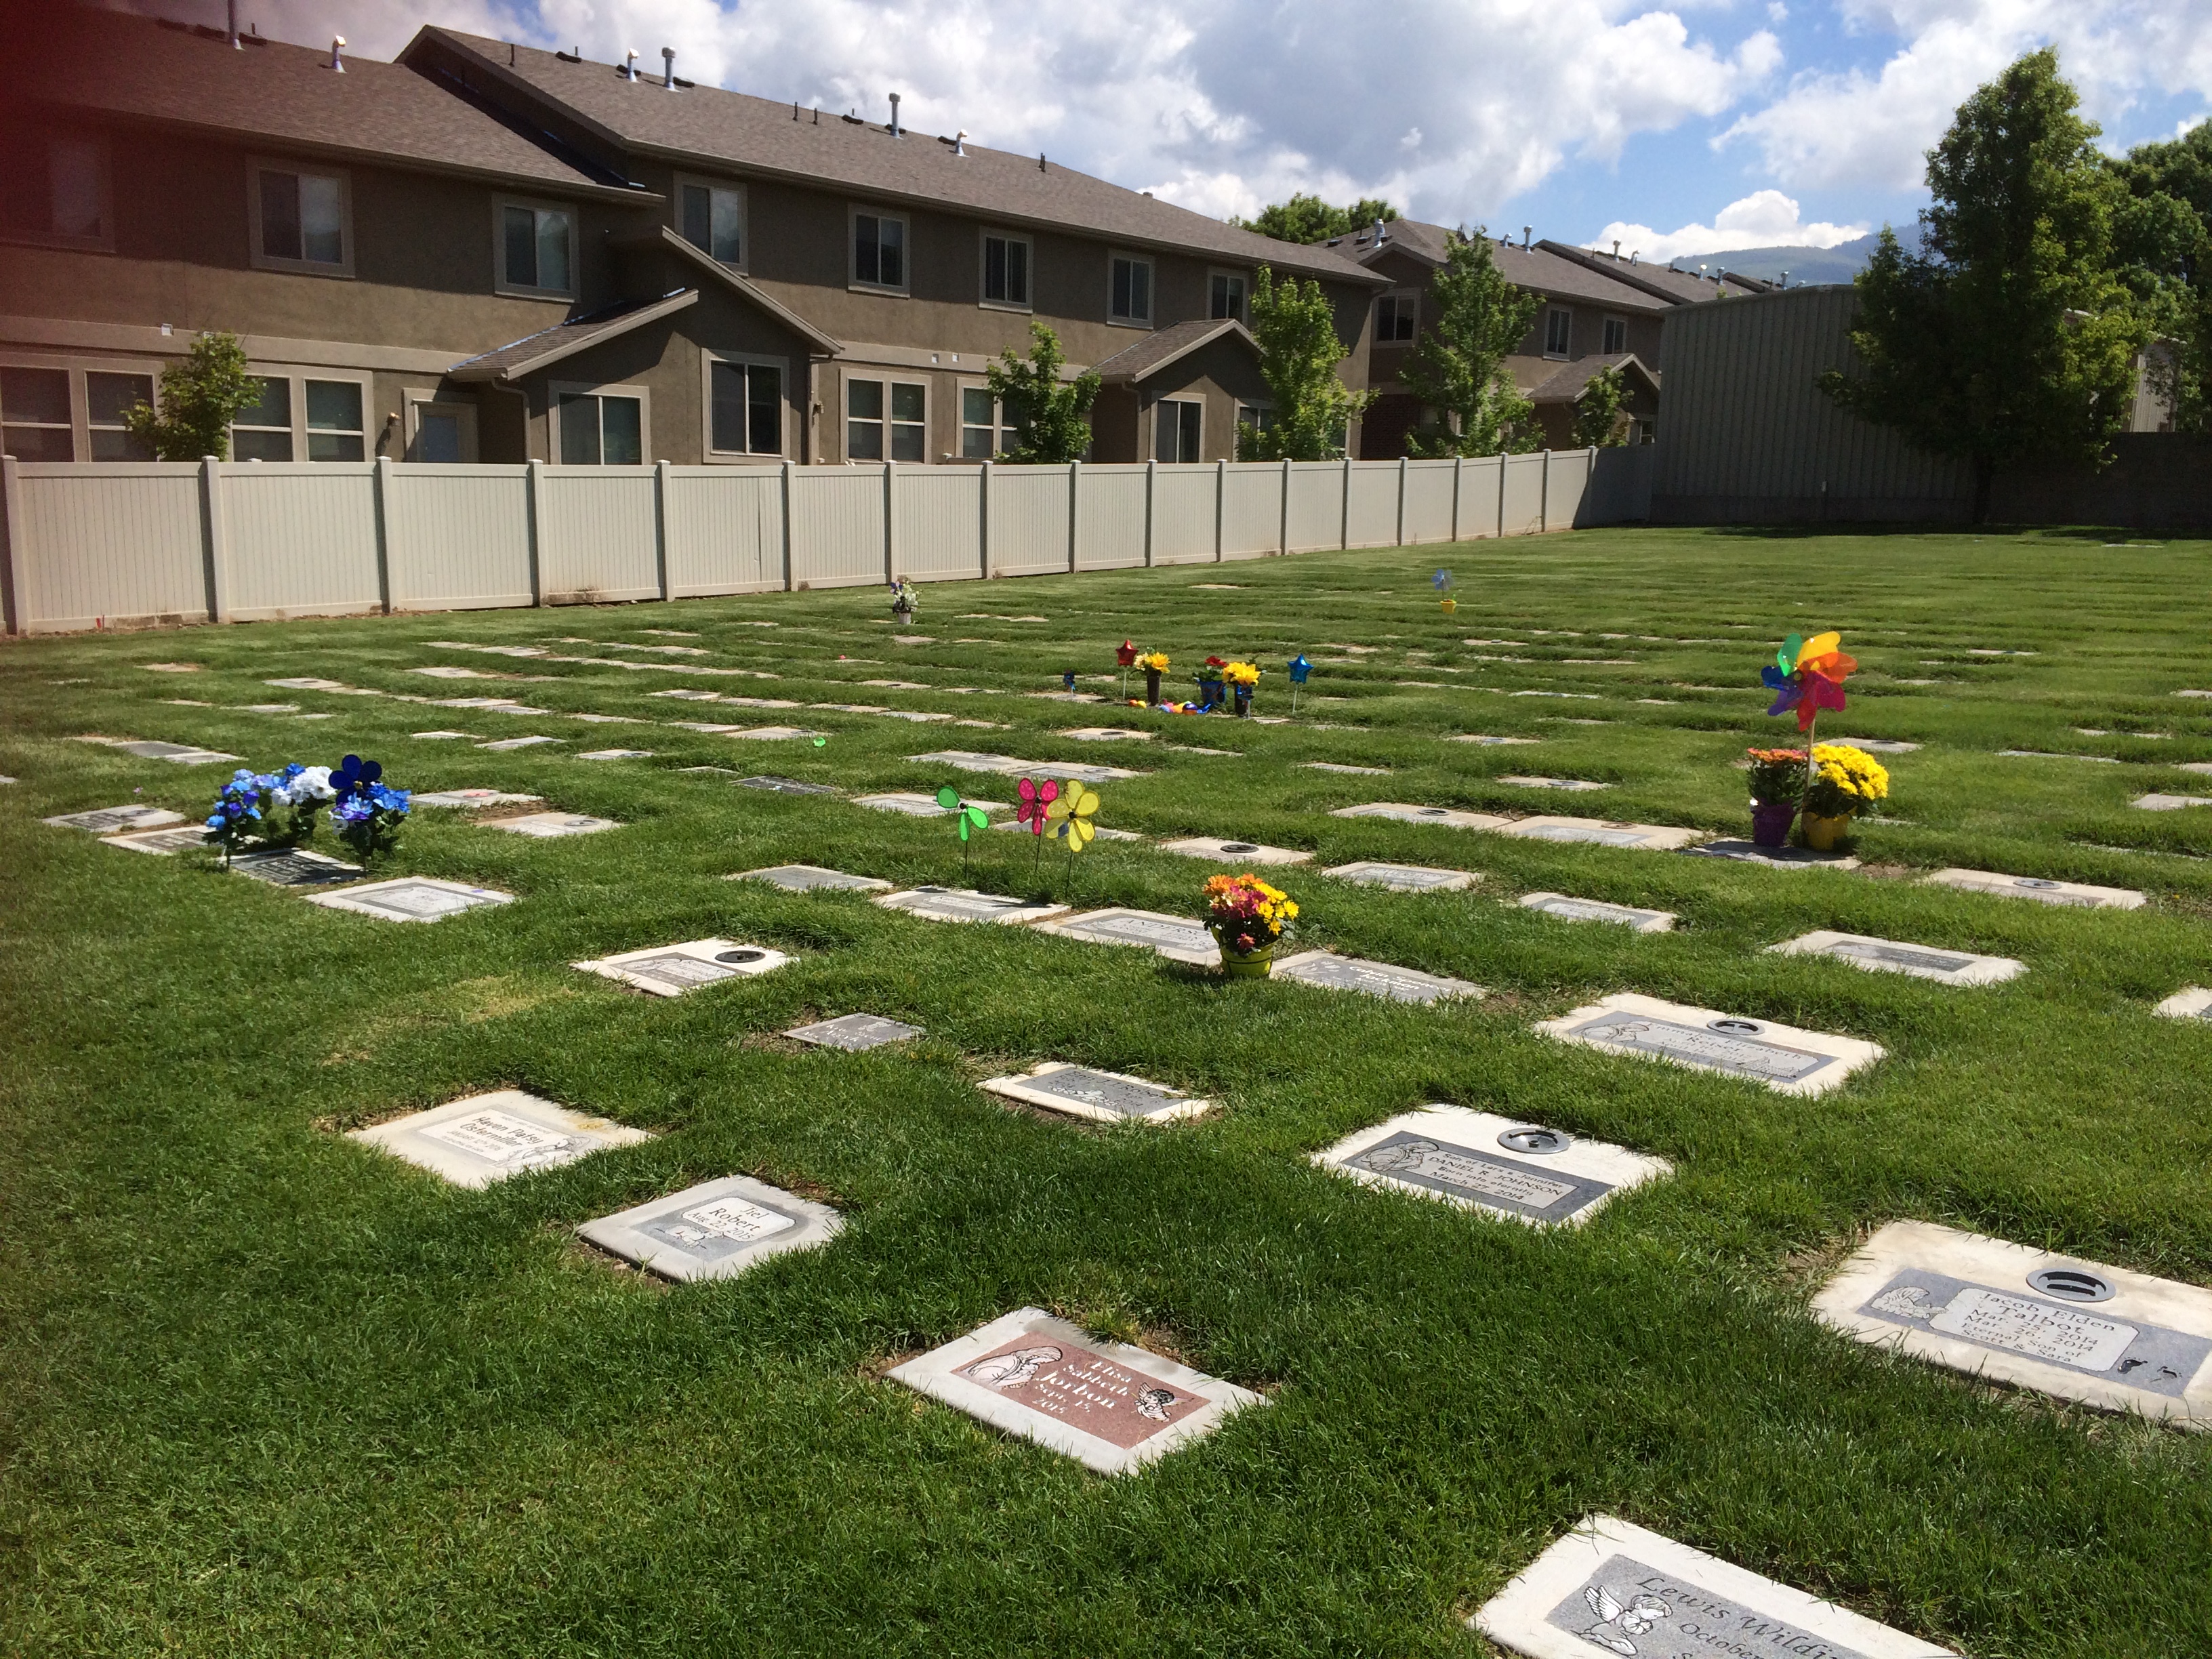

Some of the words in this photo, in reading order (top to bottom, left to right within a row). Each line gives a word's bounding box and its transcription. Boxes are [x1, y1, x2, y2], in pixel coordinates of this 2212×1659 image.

[459, 1123, 523, 1147] Ostermiller
[472, 1116, 508, 1132] Haven
[508, 1128, 544, 1145] Patsy
[1443, 1153, 1462, 1162] Son
[1428, 1156, 1474, 1173] DANIEL
[1494, 1176, 1563, 1195] JOHNSON
[1430, 1171, 1469, 1186] March
[1494, 1189, 1525, 1200] 2014
[1438, 1166, 1463, 1176] Born
[1466, 1174, 1488, 1183] into
[1490, 1181, 1534, 1196] eternity
[709, 1208, 761, 1232] Robert
[726, 1227, 755, 1240] 2015
[1979, 1293, 2040, 1313] Jacob
[2051, 1310, 2115, 1332] Elden
[1999, 1305, 2085, 1334] Talbot
[1961, 1322, 2020, 1343] Eternal
[2027, 1340, 2057, 1352] Son
[1965, 1315, 2003, 1330] Mar.
[2052, 1337, 2094, 1352] 2014
[1971, 1309, 2009, 1324] Mar.
[2057, 1331, 2099, 1346] 2014
[1961, 1329, 2005, 1345] Scott
[2013, 1343, 2026, 1351] &
[2036, 1349, 2072, 1363] Sara
[1090, 1360, 1132, 1383] Elisa
[1636, 1578, 1730, 1620] Lewis
[1739, 1616, 1838, 1659] Wildi
